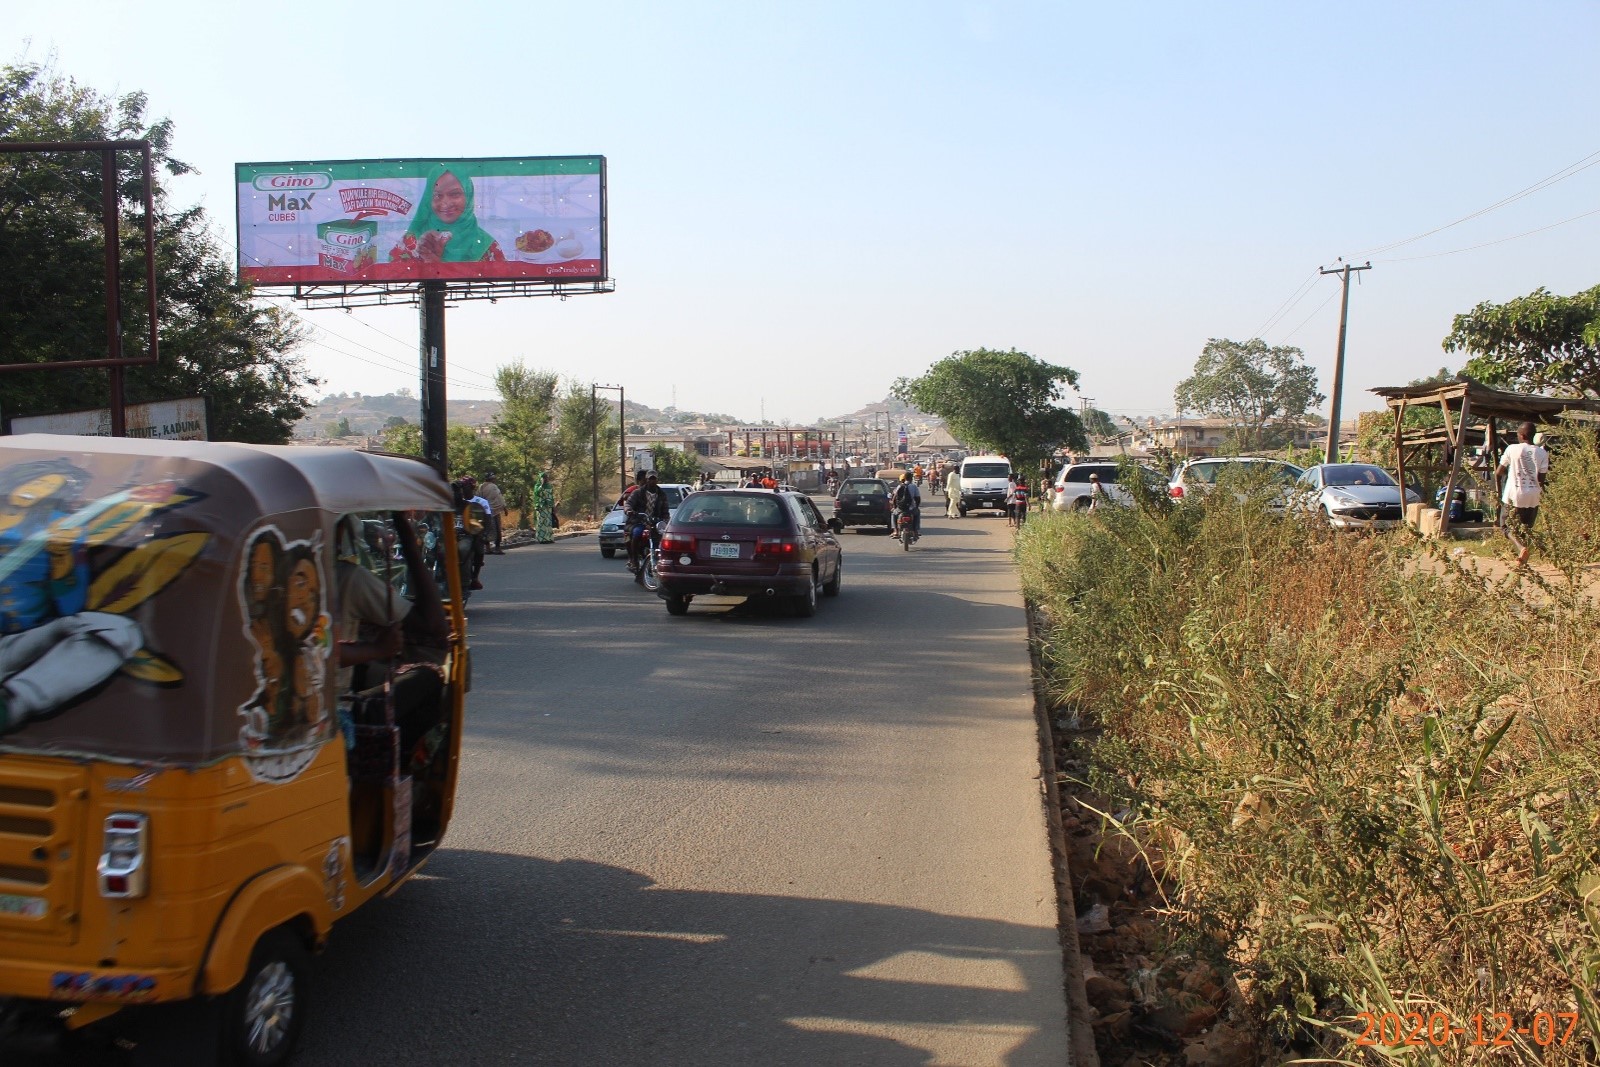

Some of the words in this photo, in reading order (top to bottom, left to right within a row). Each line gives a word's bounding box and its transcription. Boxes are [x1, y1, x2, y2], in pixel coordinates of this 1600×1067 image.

[271, 176, 314, 188] Gino
[268, 192, 316, 211] Max
[268, 213, 296, 222] CUBES
[336, 234, 364, 246] Gino
[323, 255, 347, 273] Max
[163, 420, 200, 435] KADUNA
